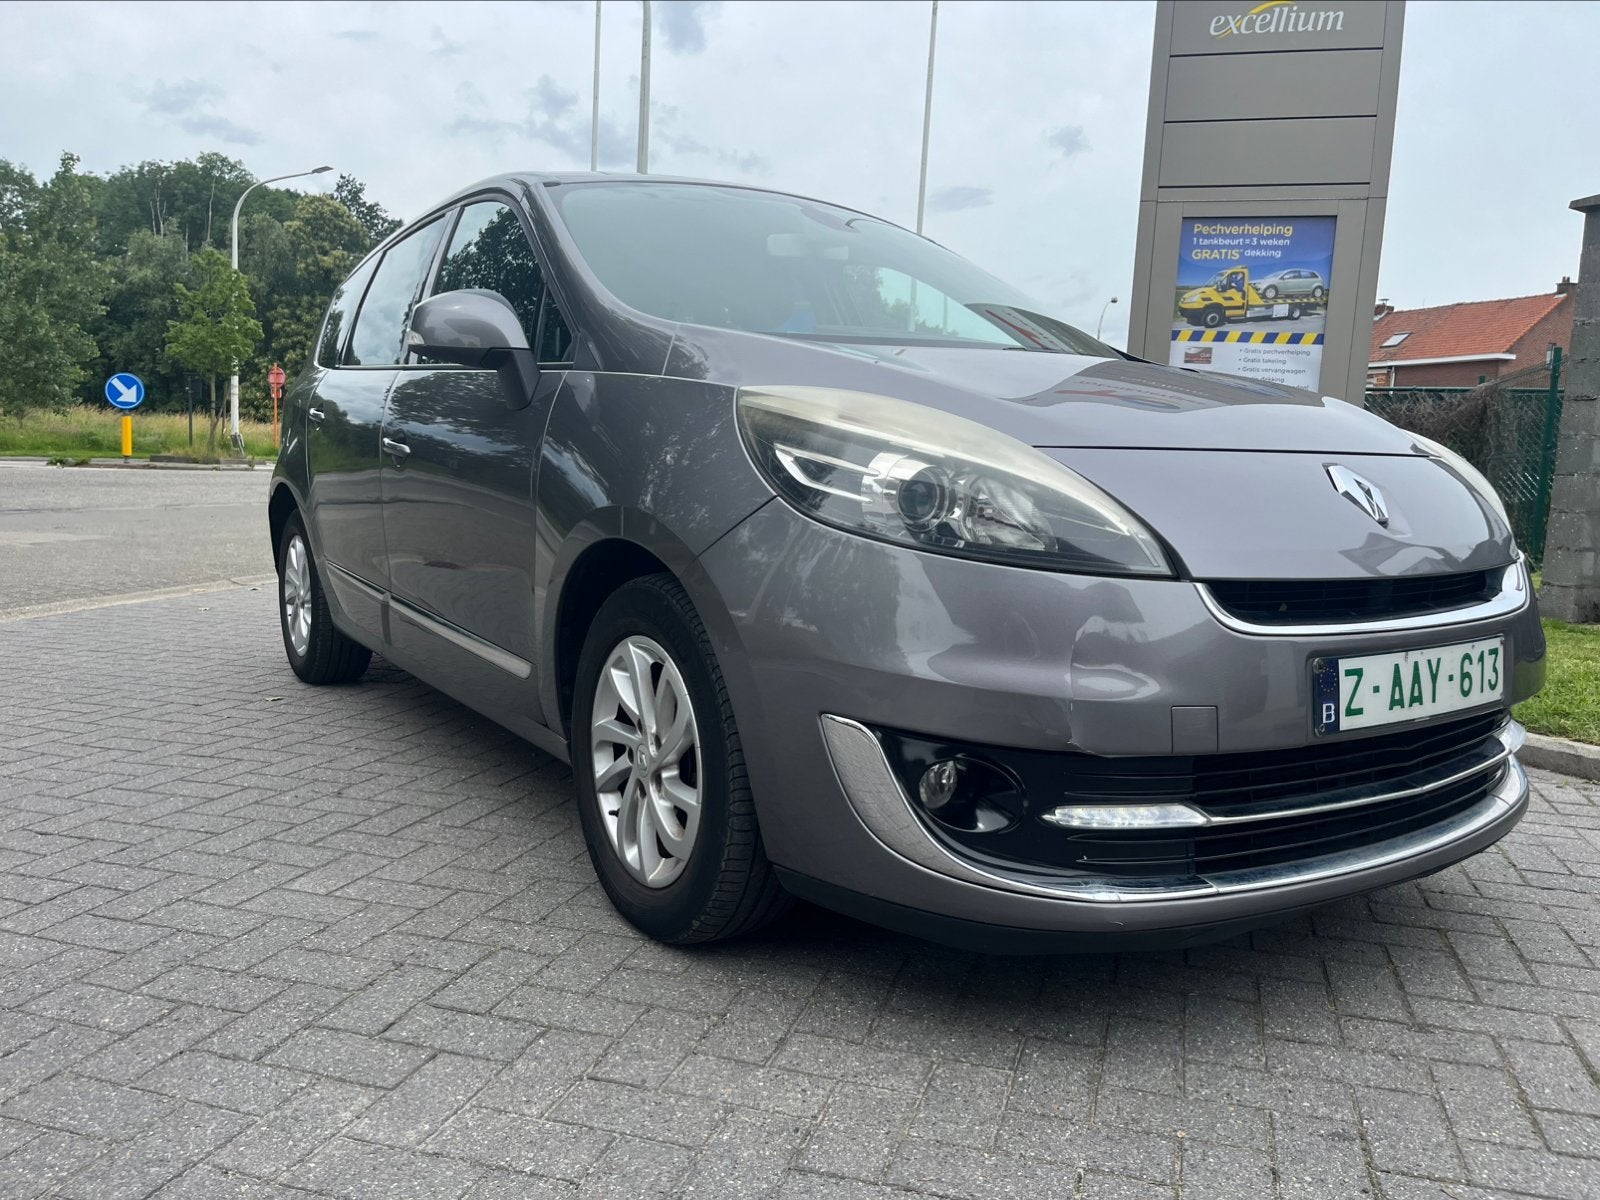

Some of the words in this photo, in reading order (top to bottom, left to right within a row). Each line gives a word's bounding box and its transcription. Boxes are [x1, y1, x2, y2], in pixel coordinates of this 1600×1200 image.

[1209, 5, 1344, 36] excellium
[1193, 223, 1293, 237] Pechverhelping
[1259, 238, 1290, 246] weken
[1244, 249, 1282, 258] dekking
[1344, 647, 1500, 718] Z-AAY-613
[1322, 703, 1335, 723] B
